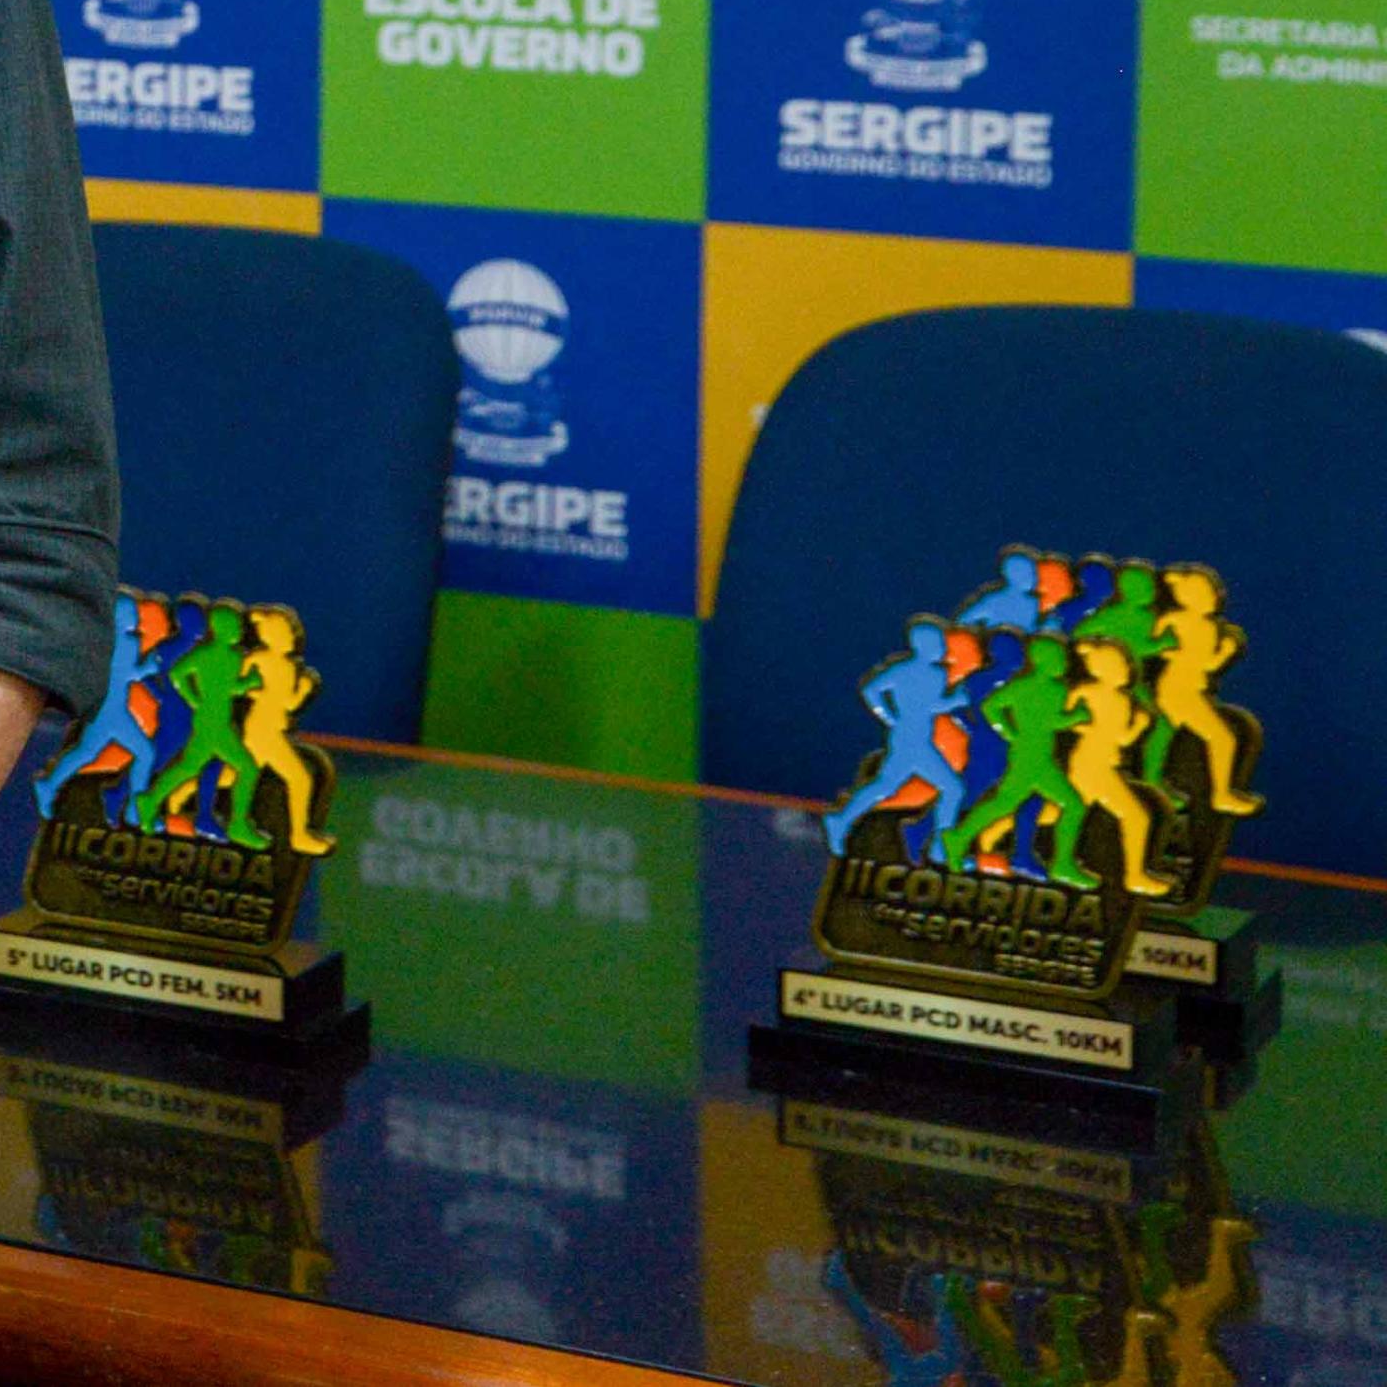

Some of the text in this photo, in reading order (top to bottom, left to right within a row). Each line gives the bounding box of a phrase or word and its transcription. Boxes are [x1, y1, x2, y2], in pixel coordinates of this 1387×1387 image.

[377, 21, 645, 77] GOVERNO
[1217, 49, 1264, 79] DA
[64, 57, 254, 112] ERGIPE
[779, 99, 1053, 161] SERGIPE
[444, 476, 628, 538] RGIPE
[78, 827, 274, 891] CORRIDA
[102, 873, 274, 921] servidores
[875, 864, 1104, 935] CORRIDA
[903, 912, 1106, 965] servidores
[1142, 945, 1208, 971] 10KM
[31, 952, 104, 981] LUGAR
[109, 965, 154, 988] PCD
[159, 973, 210, 1000] FEM.
[216, 982, 263, 1006] 5KM
[820, 992, 905, 1020] LUGAR
[910, 1006, 963, 1030] PCD
[967, 1016, 1049, 1044] MASC.
[1054, 1028, 1124, 1056] 10KM
